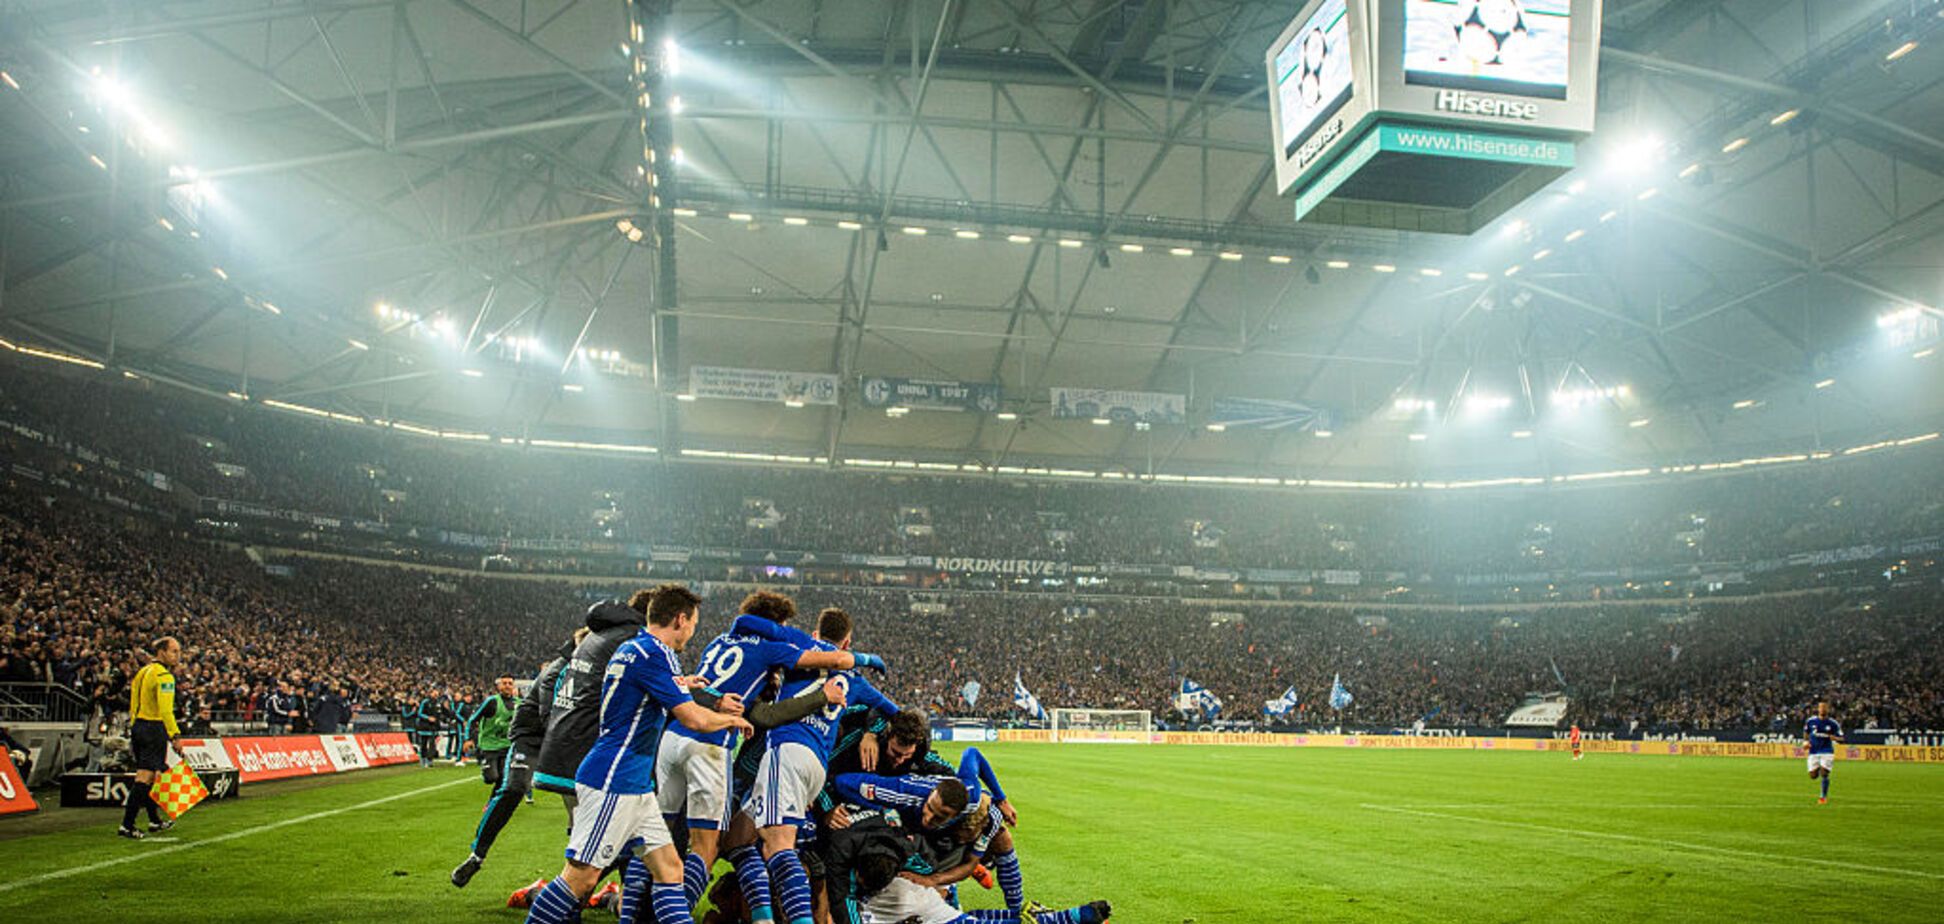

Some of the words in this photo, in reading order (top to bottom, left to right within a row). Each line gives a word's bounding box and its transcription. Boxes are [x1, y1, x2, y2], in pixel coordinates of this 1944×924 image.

[1436, 89, 1539, 119] Hisense
[1397, 131, 1559, 160] www.hisense.de
[935, 557, 1056, 575] NORDKURVE
[697, 643, 744, 689] 19
[1865, 748, 1889, 760] DON'T
[1893, 748, 1914, 761] CALL
[1917, 749, 1926, 761] IT
[1930, 749, 1944, 761] SC
[87, 776, 131, 806] sky
[212, 774, 232, 798] sky
